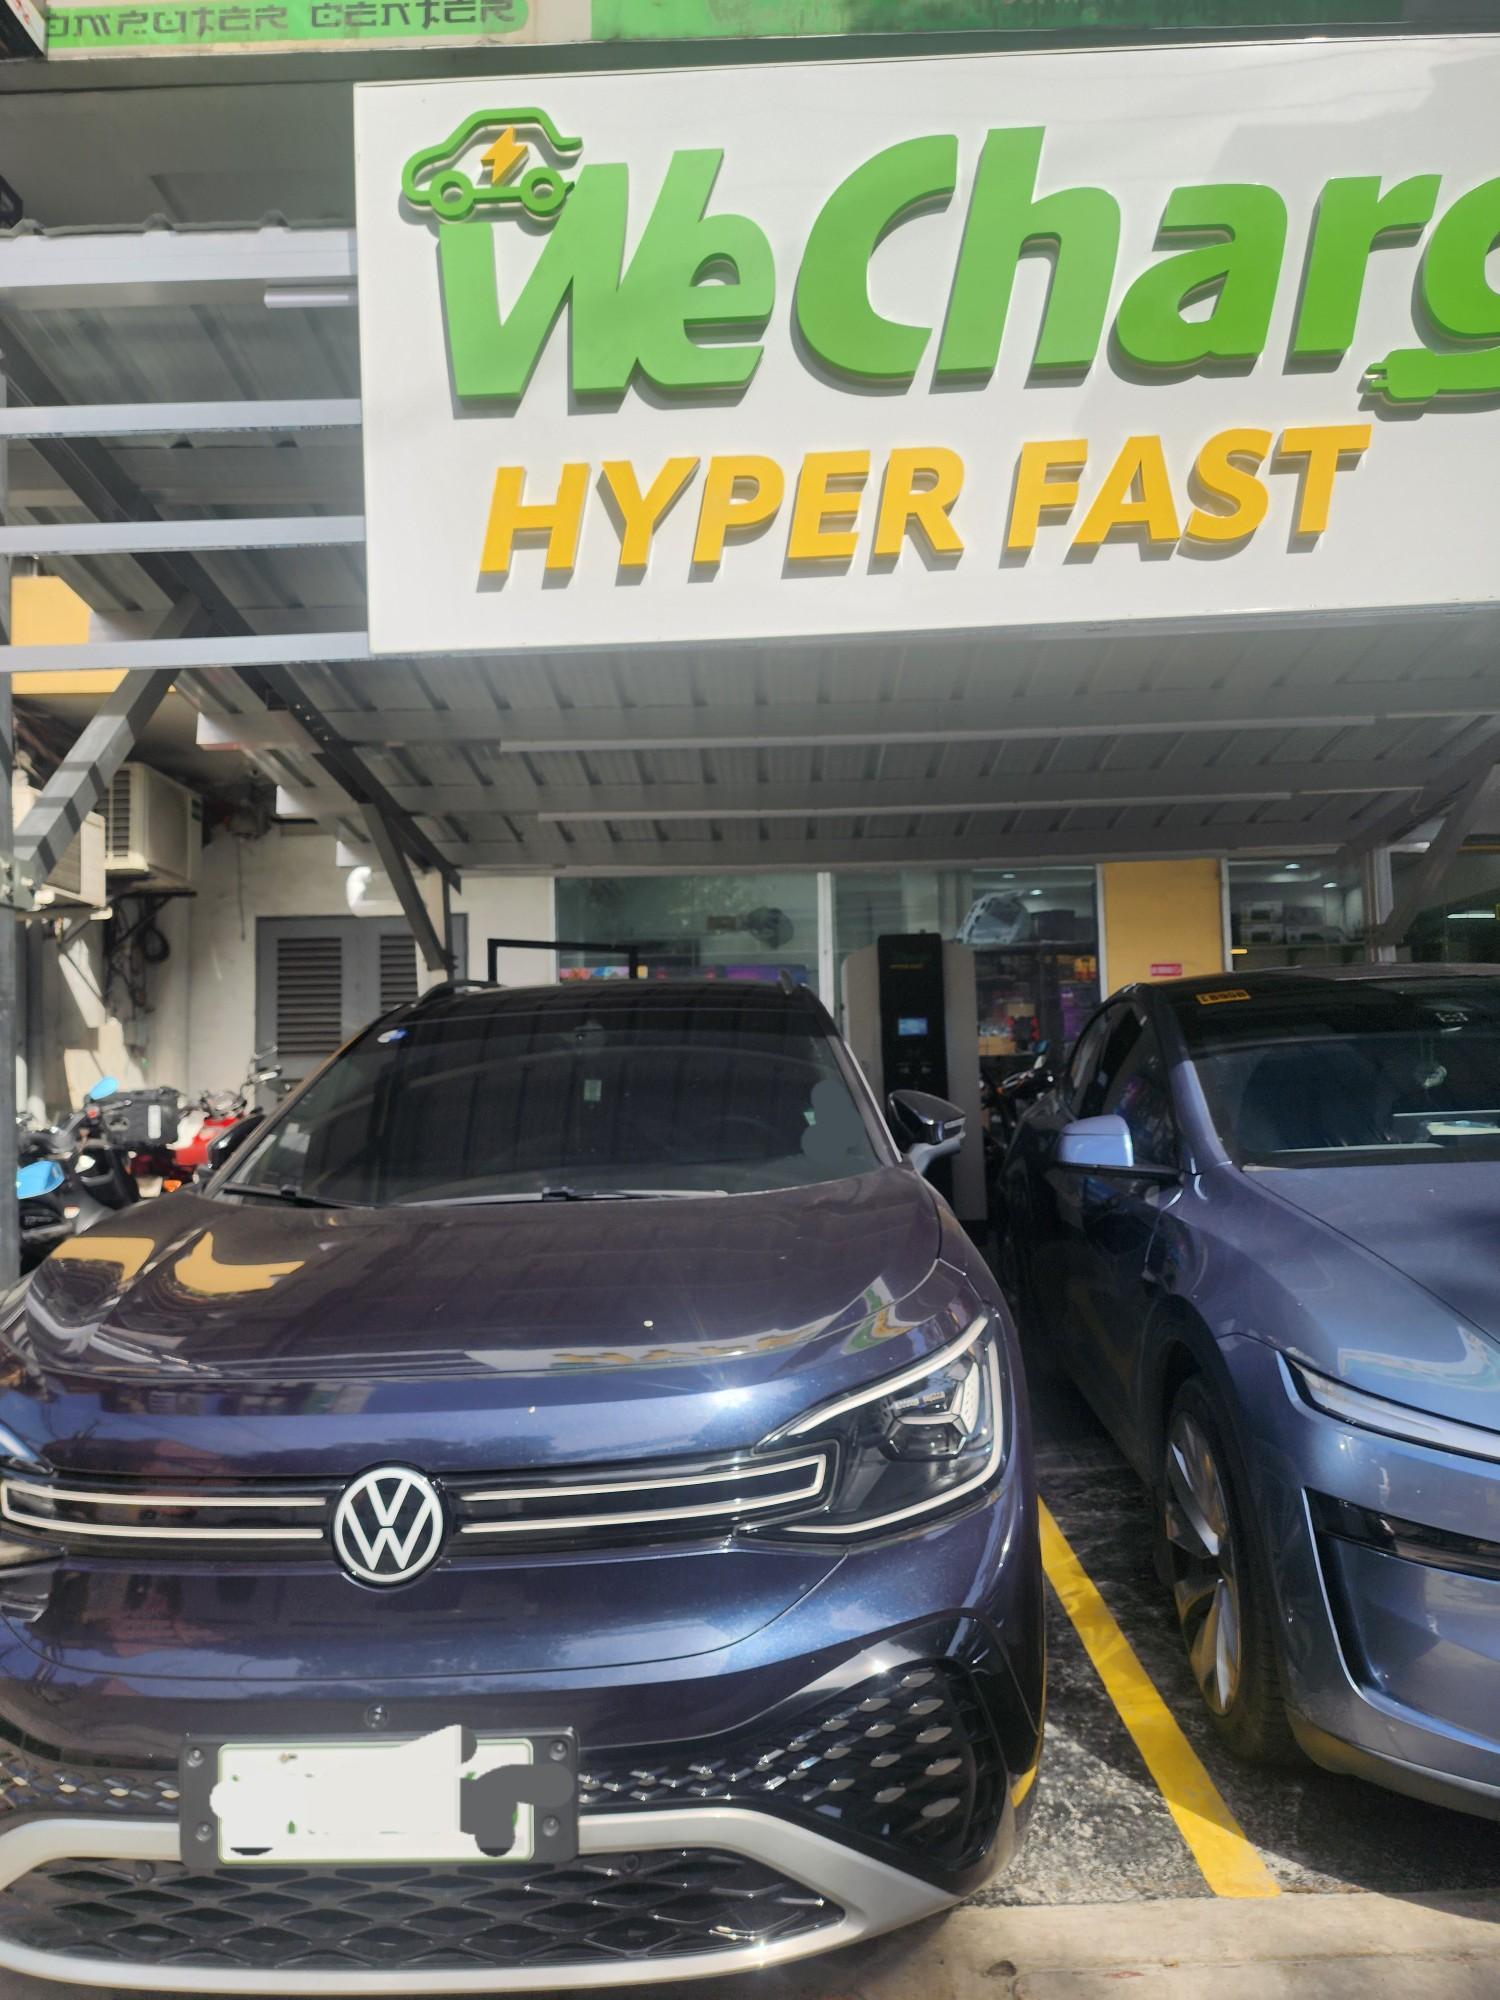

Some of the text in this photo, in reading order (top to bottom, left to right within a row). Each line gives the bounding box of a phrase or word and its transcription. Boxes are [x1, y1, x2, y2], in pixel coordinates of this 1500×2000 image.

[311, 0, 515, 29] CENTER
[481, 425, 1371, 573] HYPER FAST
